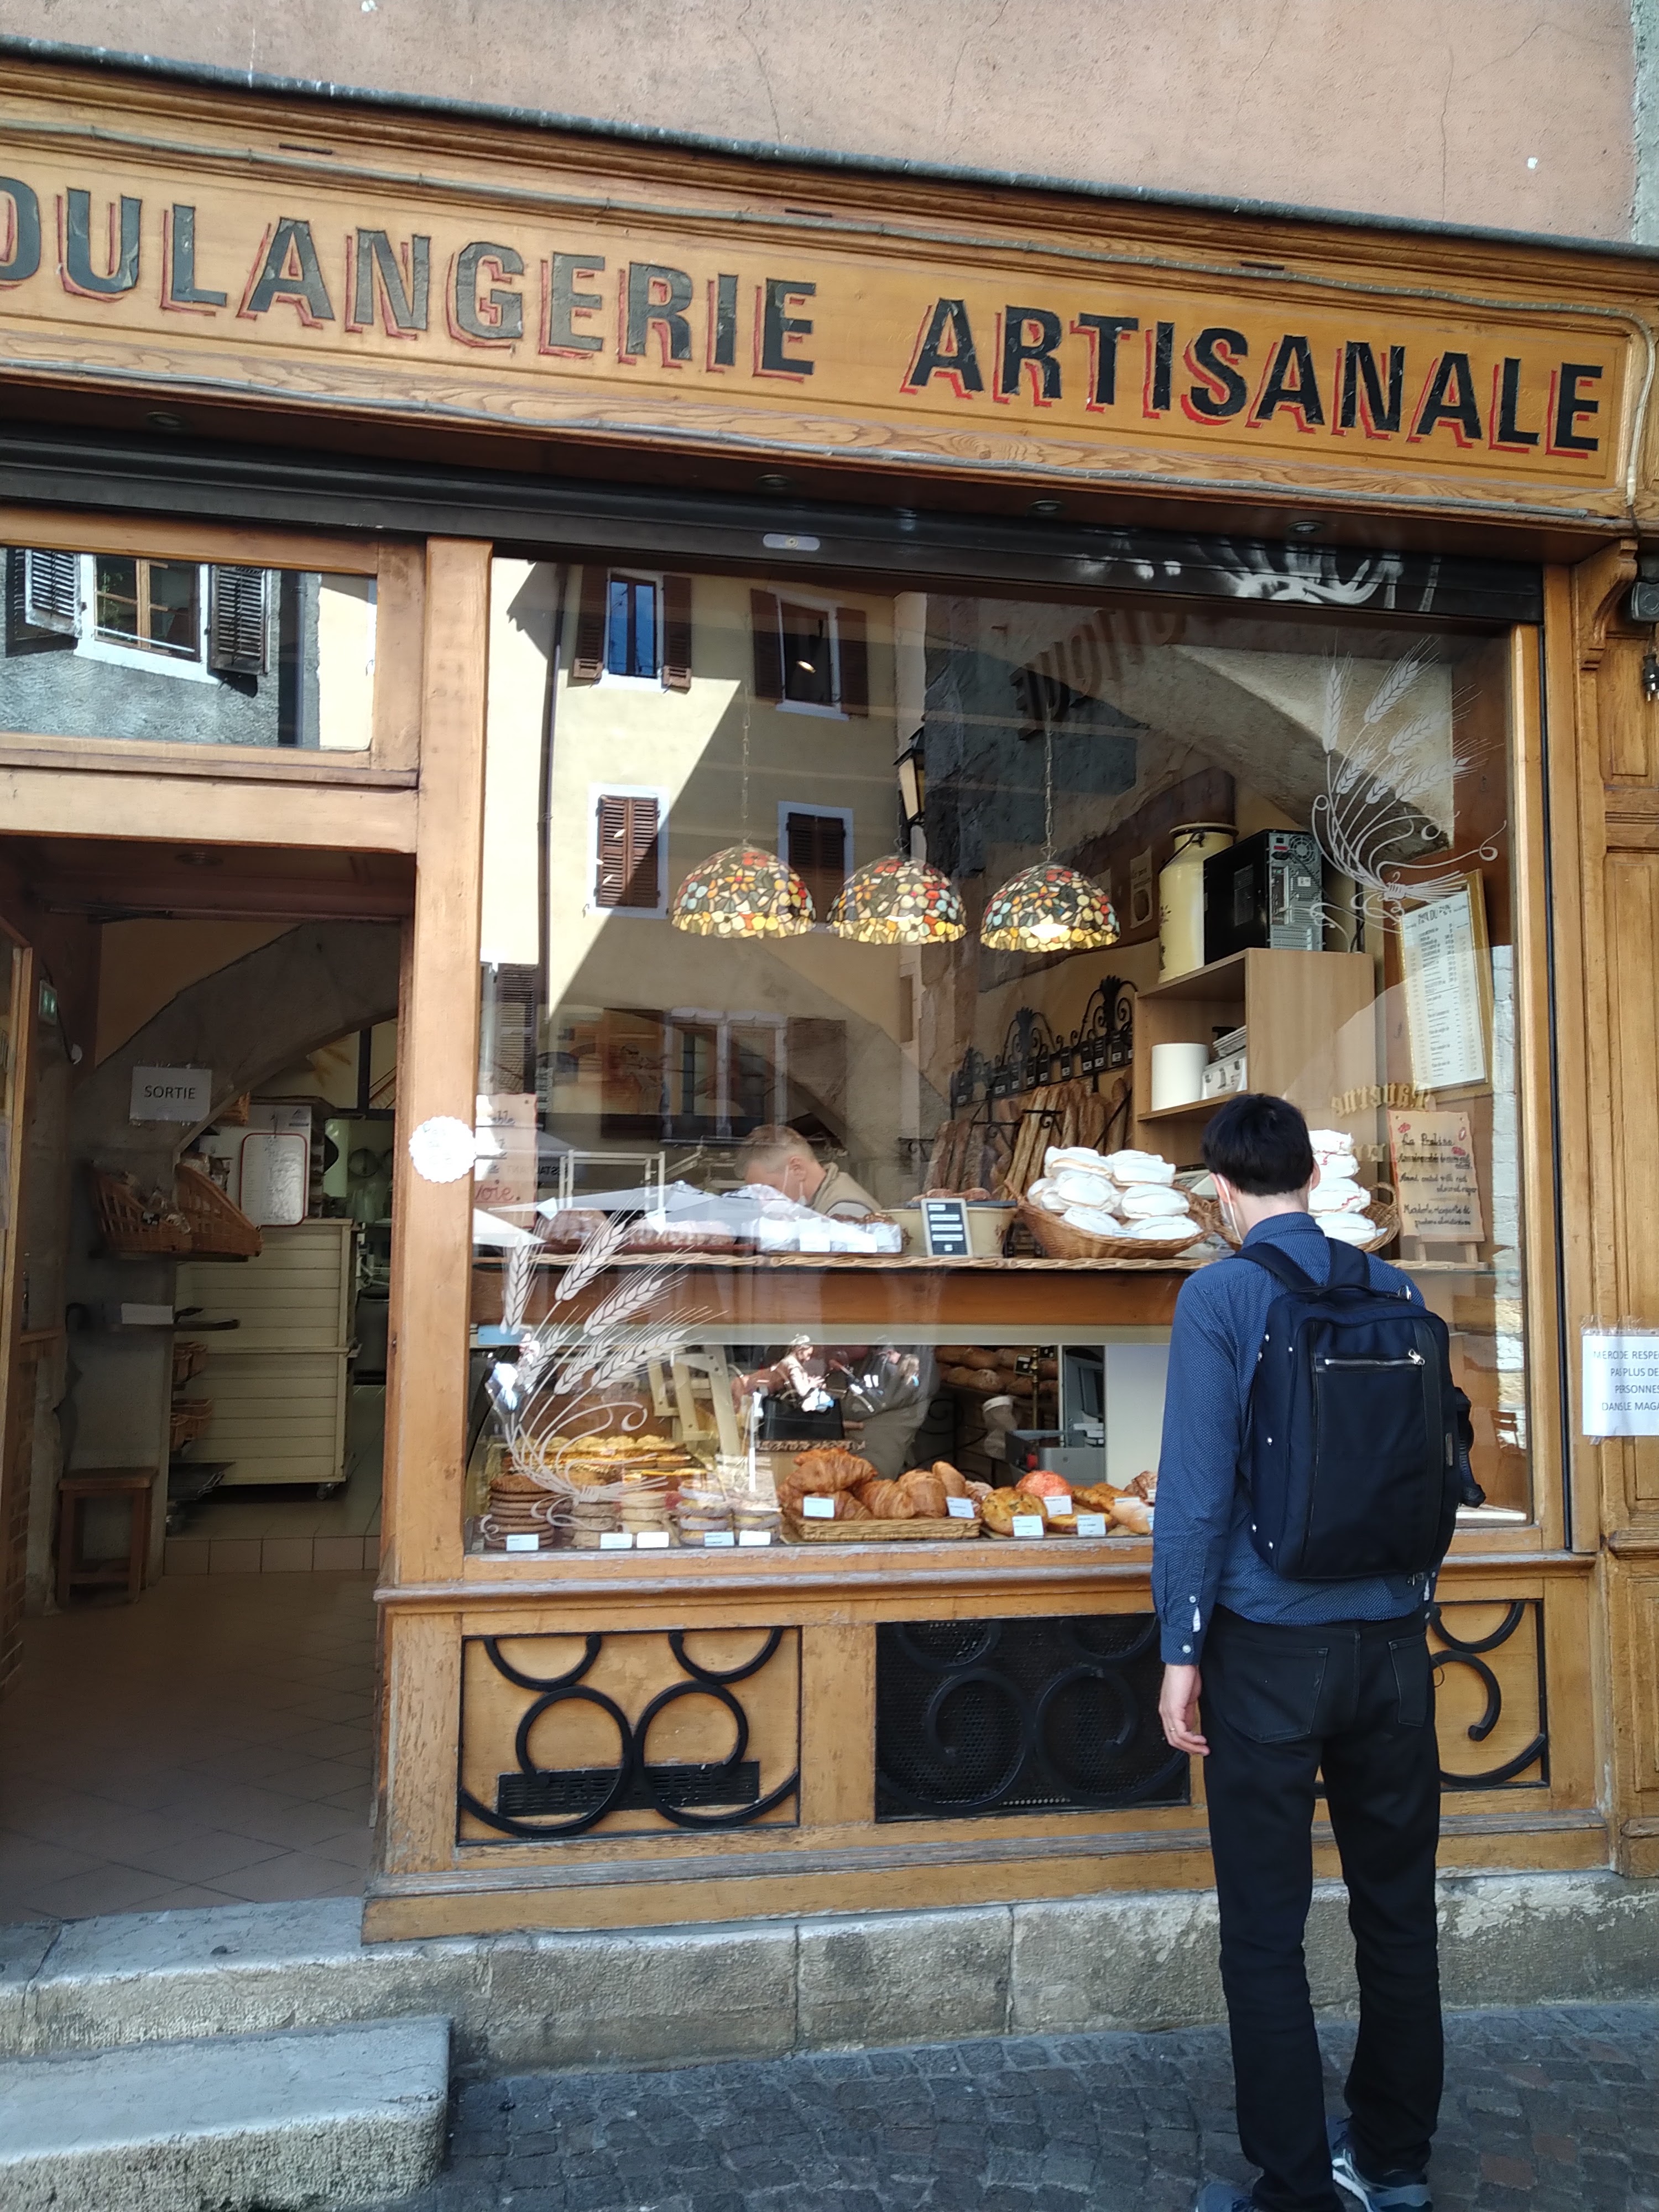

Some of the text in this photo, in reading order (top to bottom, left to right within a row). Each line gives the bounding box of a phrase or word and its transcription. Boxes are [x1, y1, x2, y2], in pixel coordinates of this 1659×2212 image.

[899, 297, 1603, 459] ARTISANALE
[144, 1085, 196, 1099] SORTIE
[1632, 1350, 1659, 1360] RESPE
[1610, 1368, 1659, 1377] PAS PLUS DE
[1623, 1402, 1632, 1411] LE
